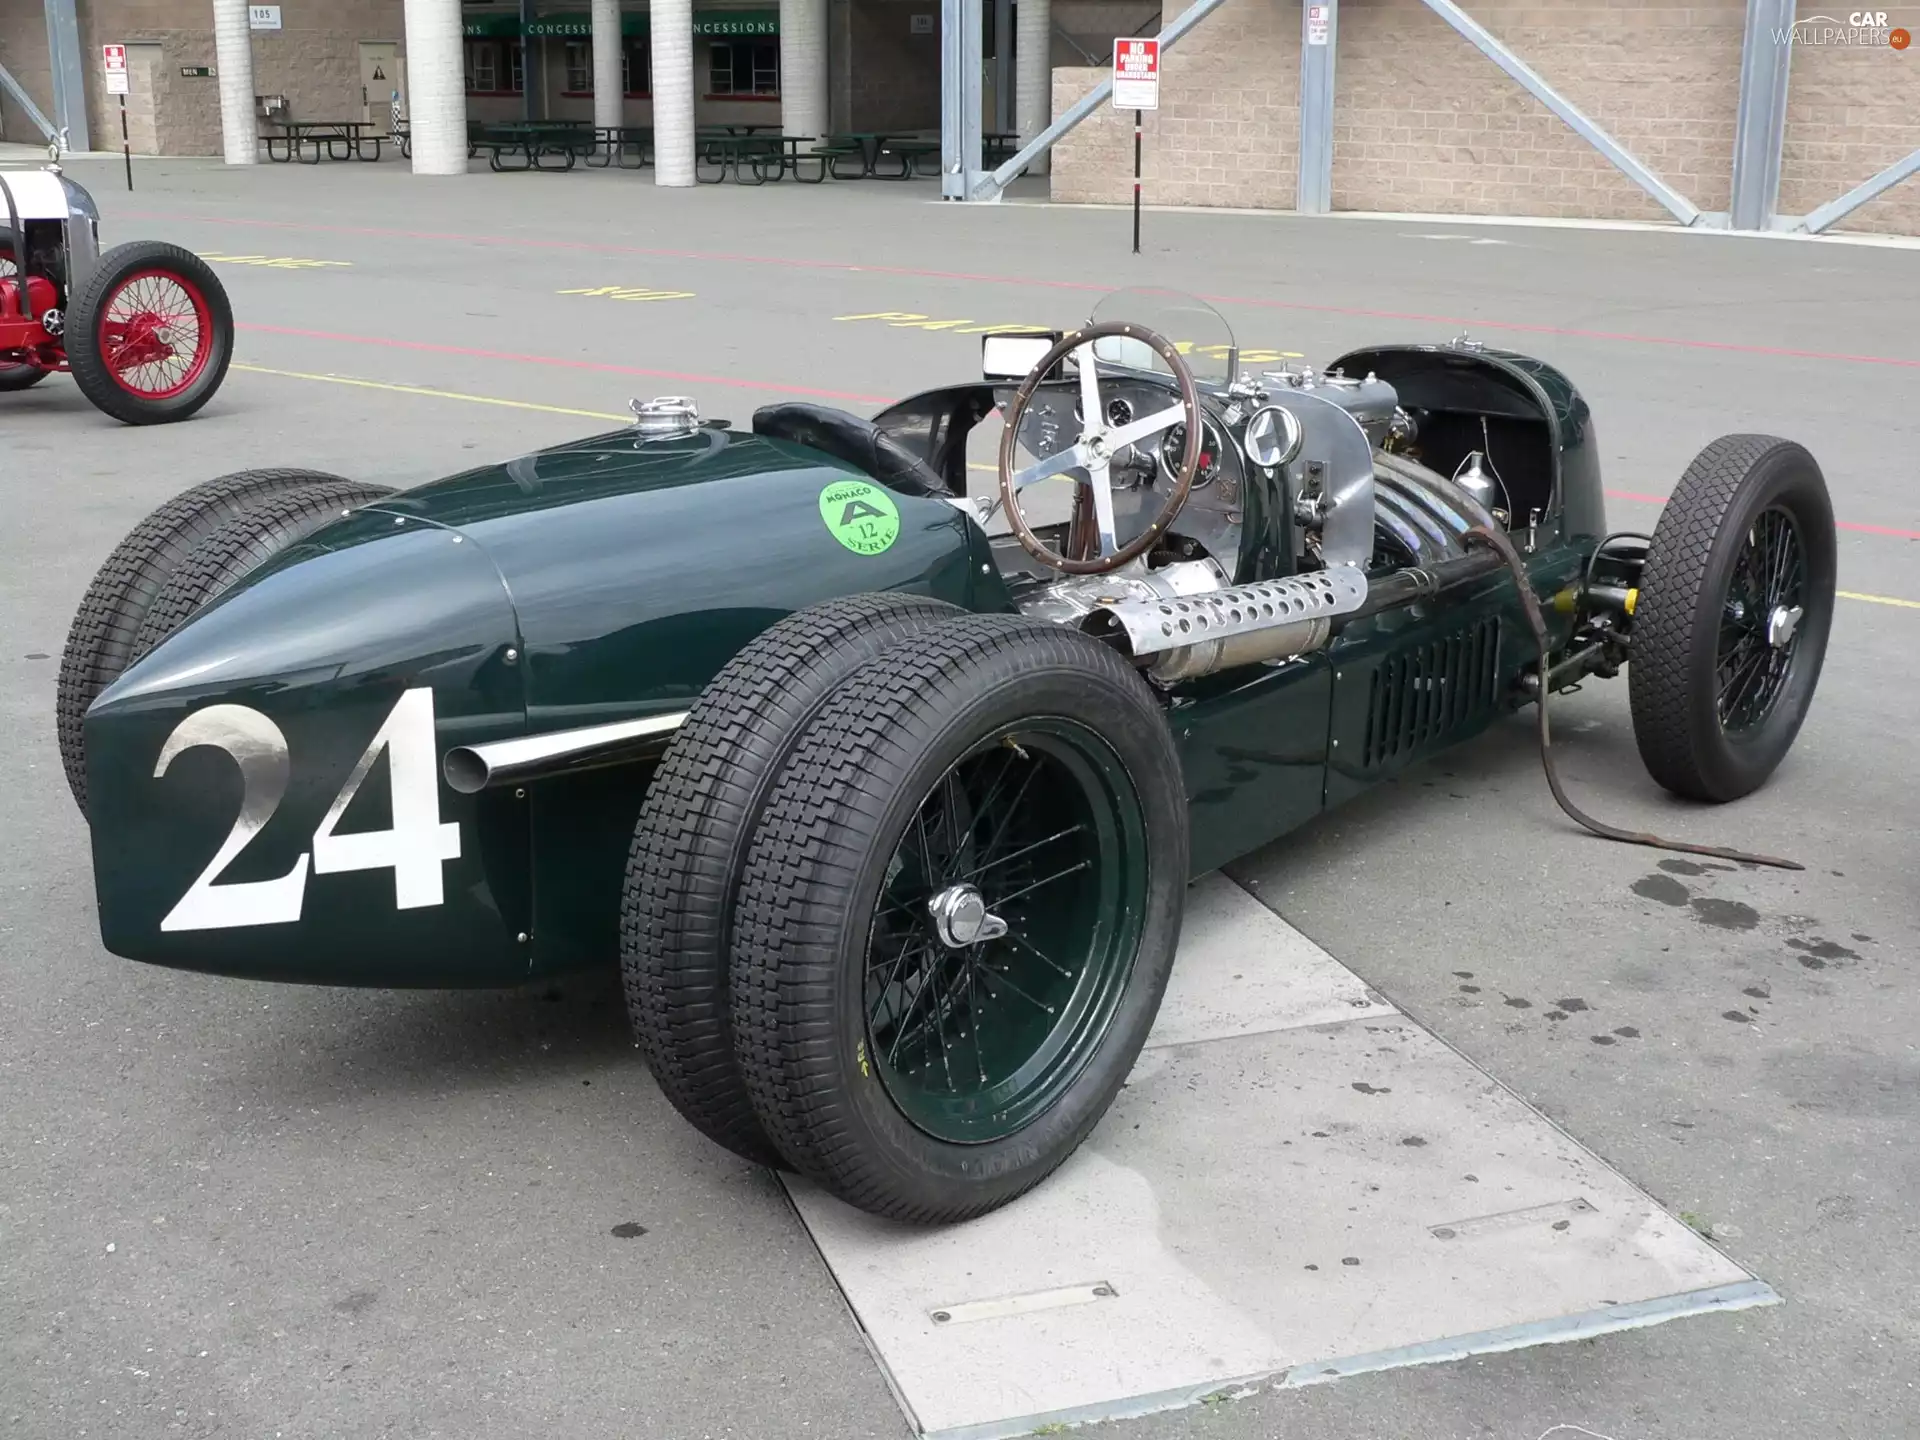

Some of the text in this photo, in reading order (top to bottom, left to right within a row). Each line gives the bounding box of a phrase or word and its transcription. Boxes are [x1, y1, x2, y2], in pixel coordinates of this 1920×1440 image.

[254, 9, 271, 19] 105
[1129, 42, 1145, 54] NO
[1120, 53, 1154, 64] PARKING
[182, 68, 198, 76] MEN
[826, 487, 871, 503] MONACO
[840, 500, 888, 526] A
[859, 523, 878, 539] 12
[153, 687, 461, 932] 24
